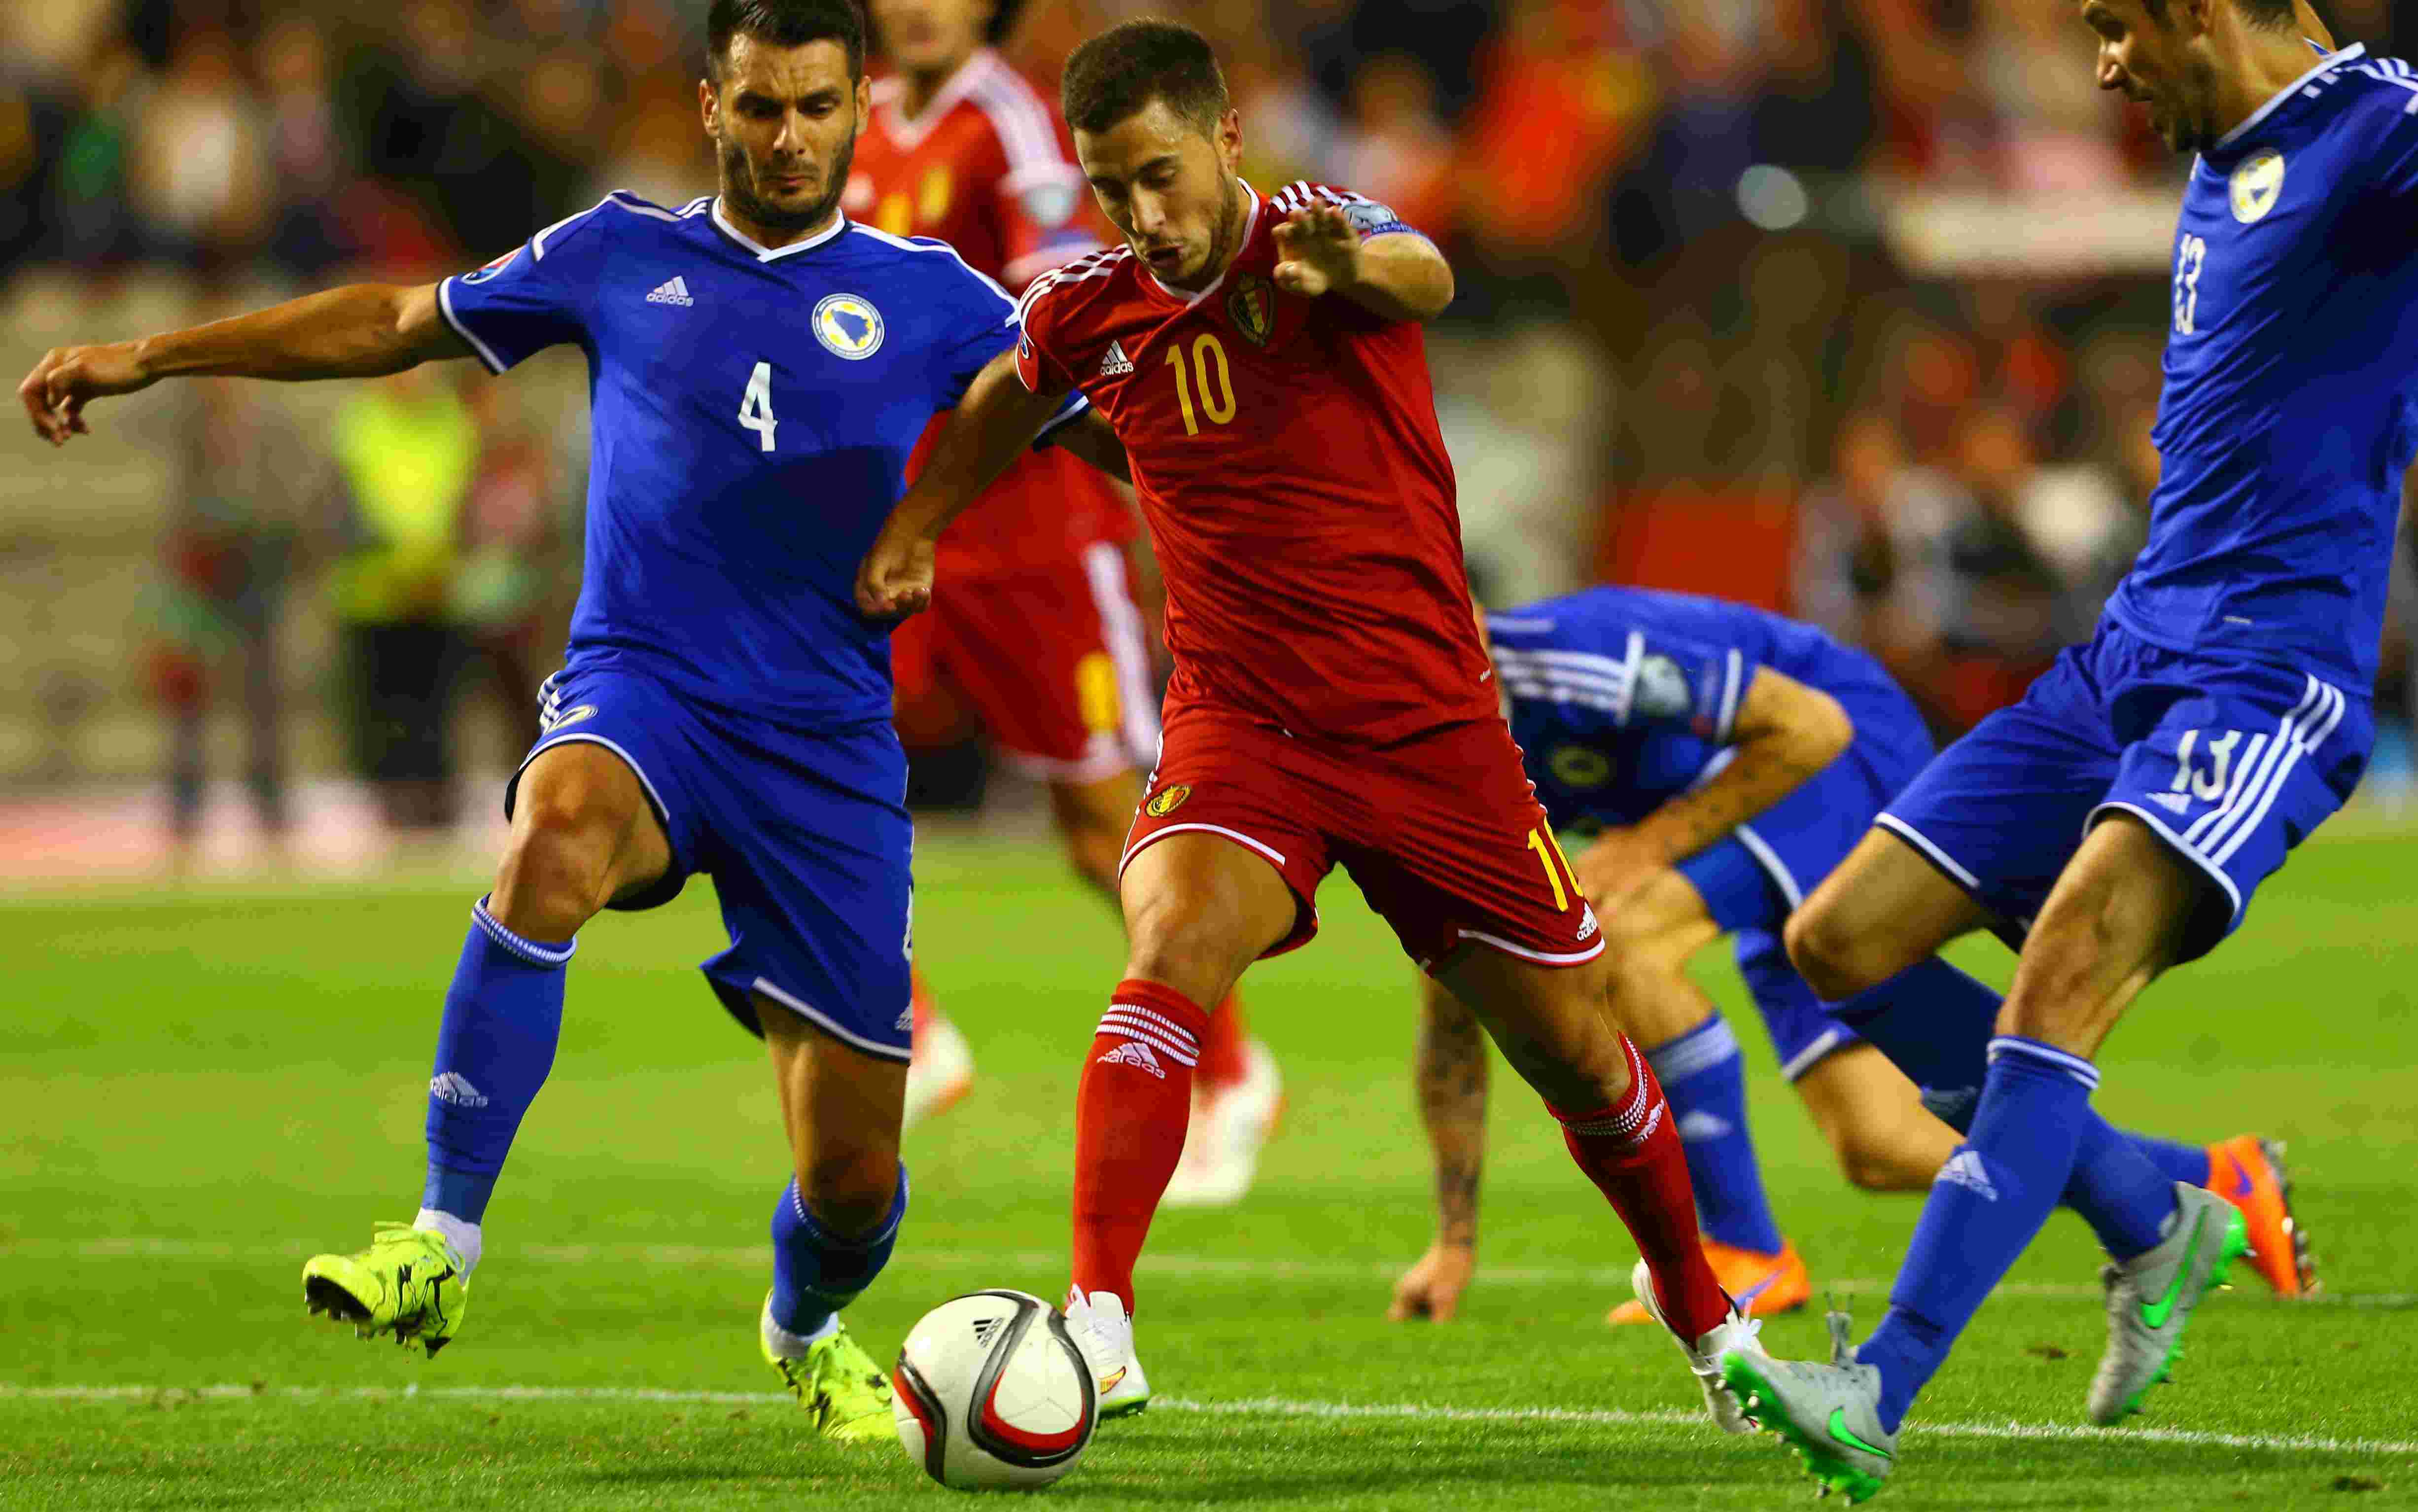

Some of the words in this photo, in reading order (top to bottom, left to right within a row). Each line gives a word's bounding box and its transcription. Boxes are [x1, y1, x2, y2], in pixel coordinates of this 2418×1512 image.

[645, 292, 695, 307] adidas
[2174, 233, 2207, 335] 13
[1100, 361, 1134, 376] adidas
[1164, 333, 1236, 436] 10
[737, 361, 778, 452] 4
[1097, 1048, 1166, 1079] adidas
